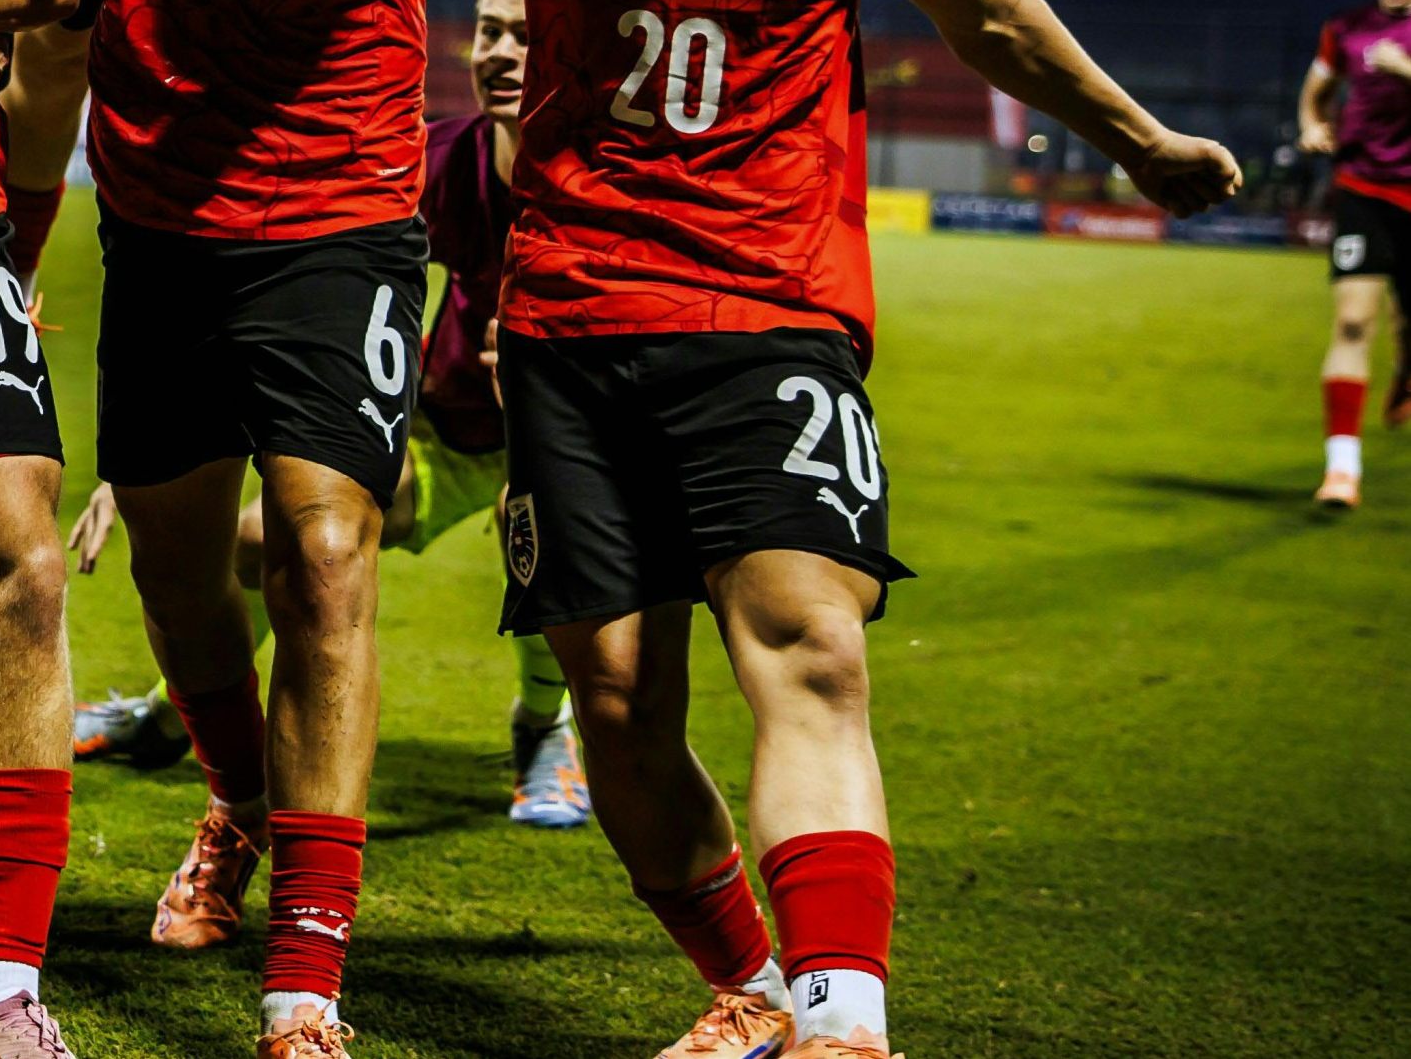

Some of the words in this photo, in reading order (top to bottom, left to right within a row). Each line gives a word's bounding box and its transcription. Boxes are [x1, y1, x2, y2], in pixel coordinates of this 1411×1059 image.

[609, 9, 727, 134] 20
[364, 285, 406, 396] 6
[776, 376, 881, 501] 20
